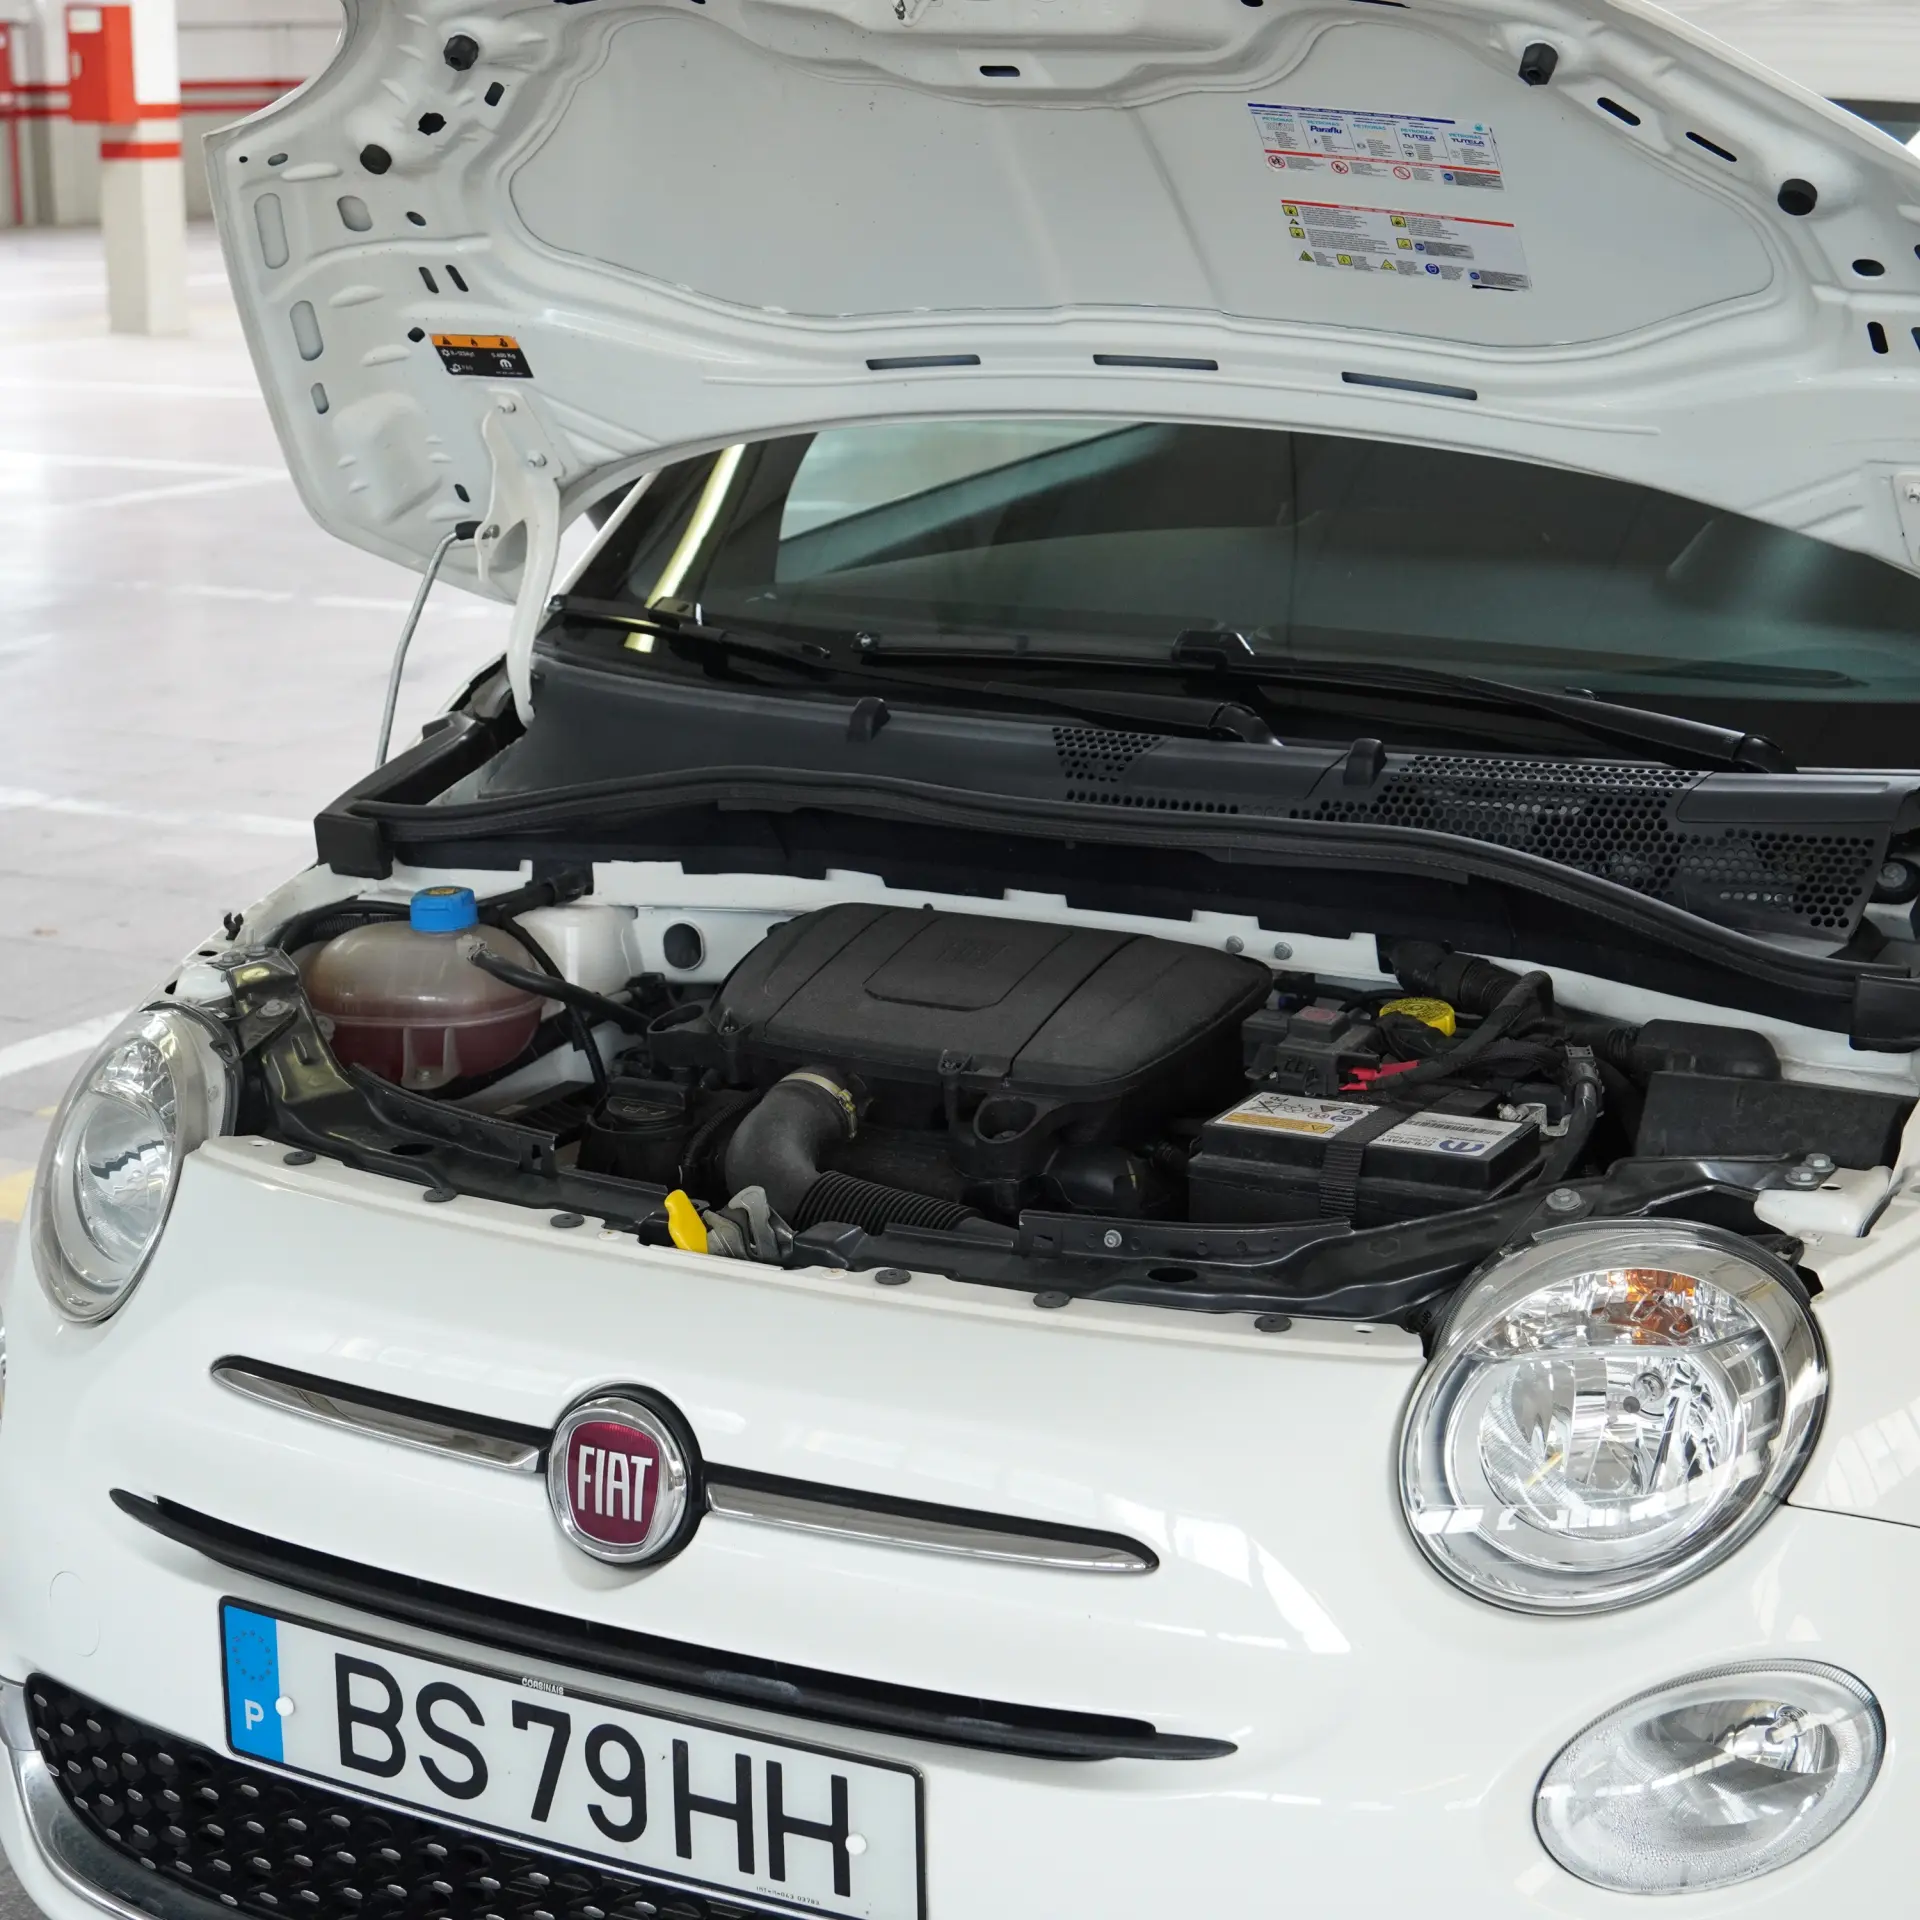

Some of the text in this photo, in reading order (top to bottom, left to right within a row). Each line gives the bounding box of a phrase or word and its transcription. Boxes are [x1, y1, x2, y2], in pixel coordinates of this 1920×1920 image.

[1310, 125, 1342, 134] Paraflu
[1402, 132, 1437, 140] TUTELA
[1450, 137, 1486, 146] TUTELA
[577, 1445, 653, 1522] FIAT
[244, 1698, 265, 1731] P
